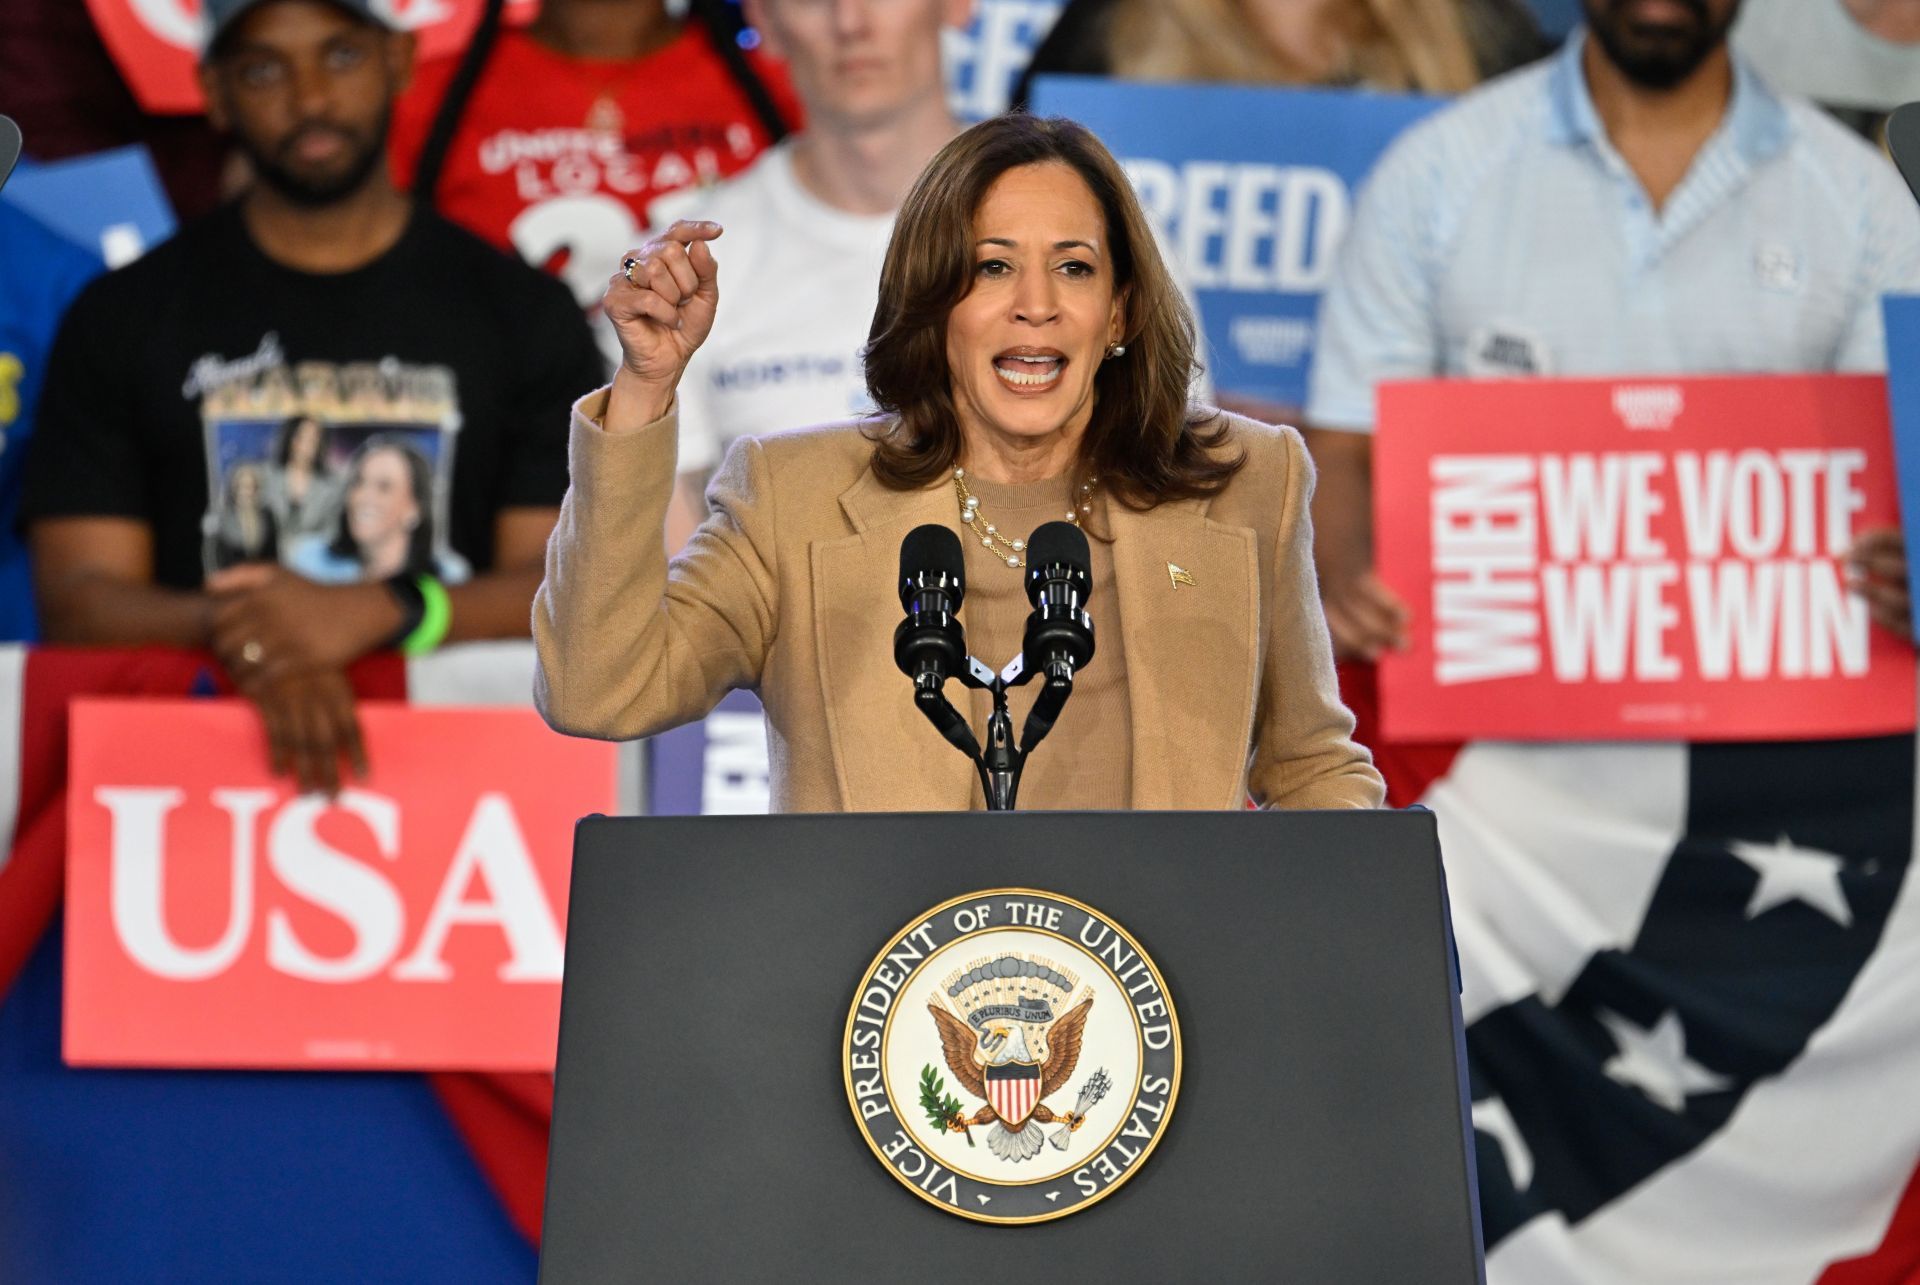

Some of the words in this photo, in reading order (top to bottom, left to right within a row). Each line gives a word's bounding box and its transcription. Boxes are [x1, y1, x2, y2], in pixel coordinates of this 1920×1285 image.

[1540, 452, 1666, 561] WE
[1675, 448, 1867, 560] VOTE
[1430, 454, 1540, 686] WHEN
[1541, 561, 1681, 683] WE
[1687, 560, 1869, 680] WIN
[93, 786, 564, 983] USA
[953, 904, 991, 932] OF
[1005, 902, 1064, 931] THE
[852, 923, 939, 1121] PRESIDENT
[978, 1006, 1021, 1018] PLURIBUS
[1080, 916, 1171, 1050] UNITED
[882, 1130, 960, 1206] VICE
[1073, 1074, 1170, 1198] STATES
